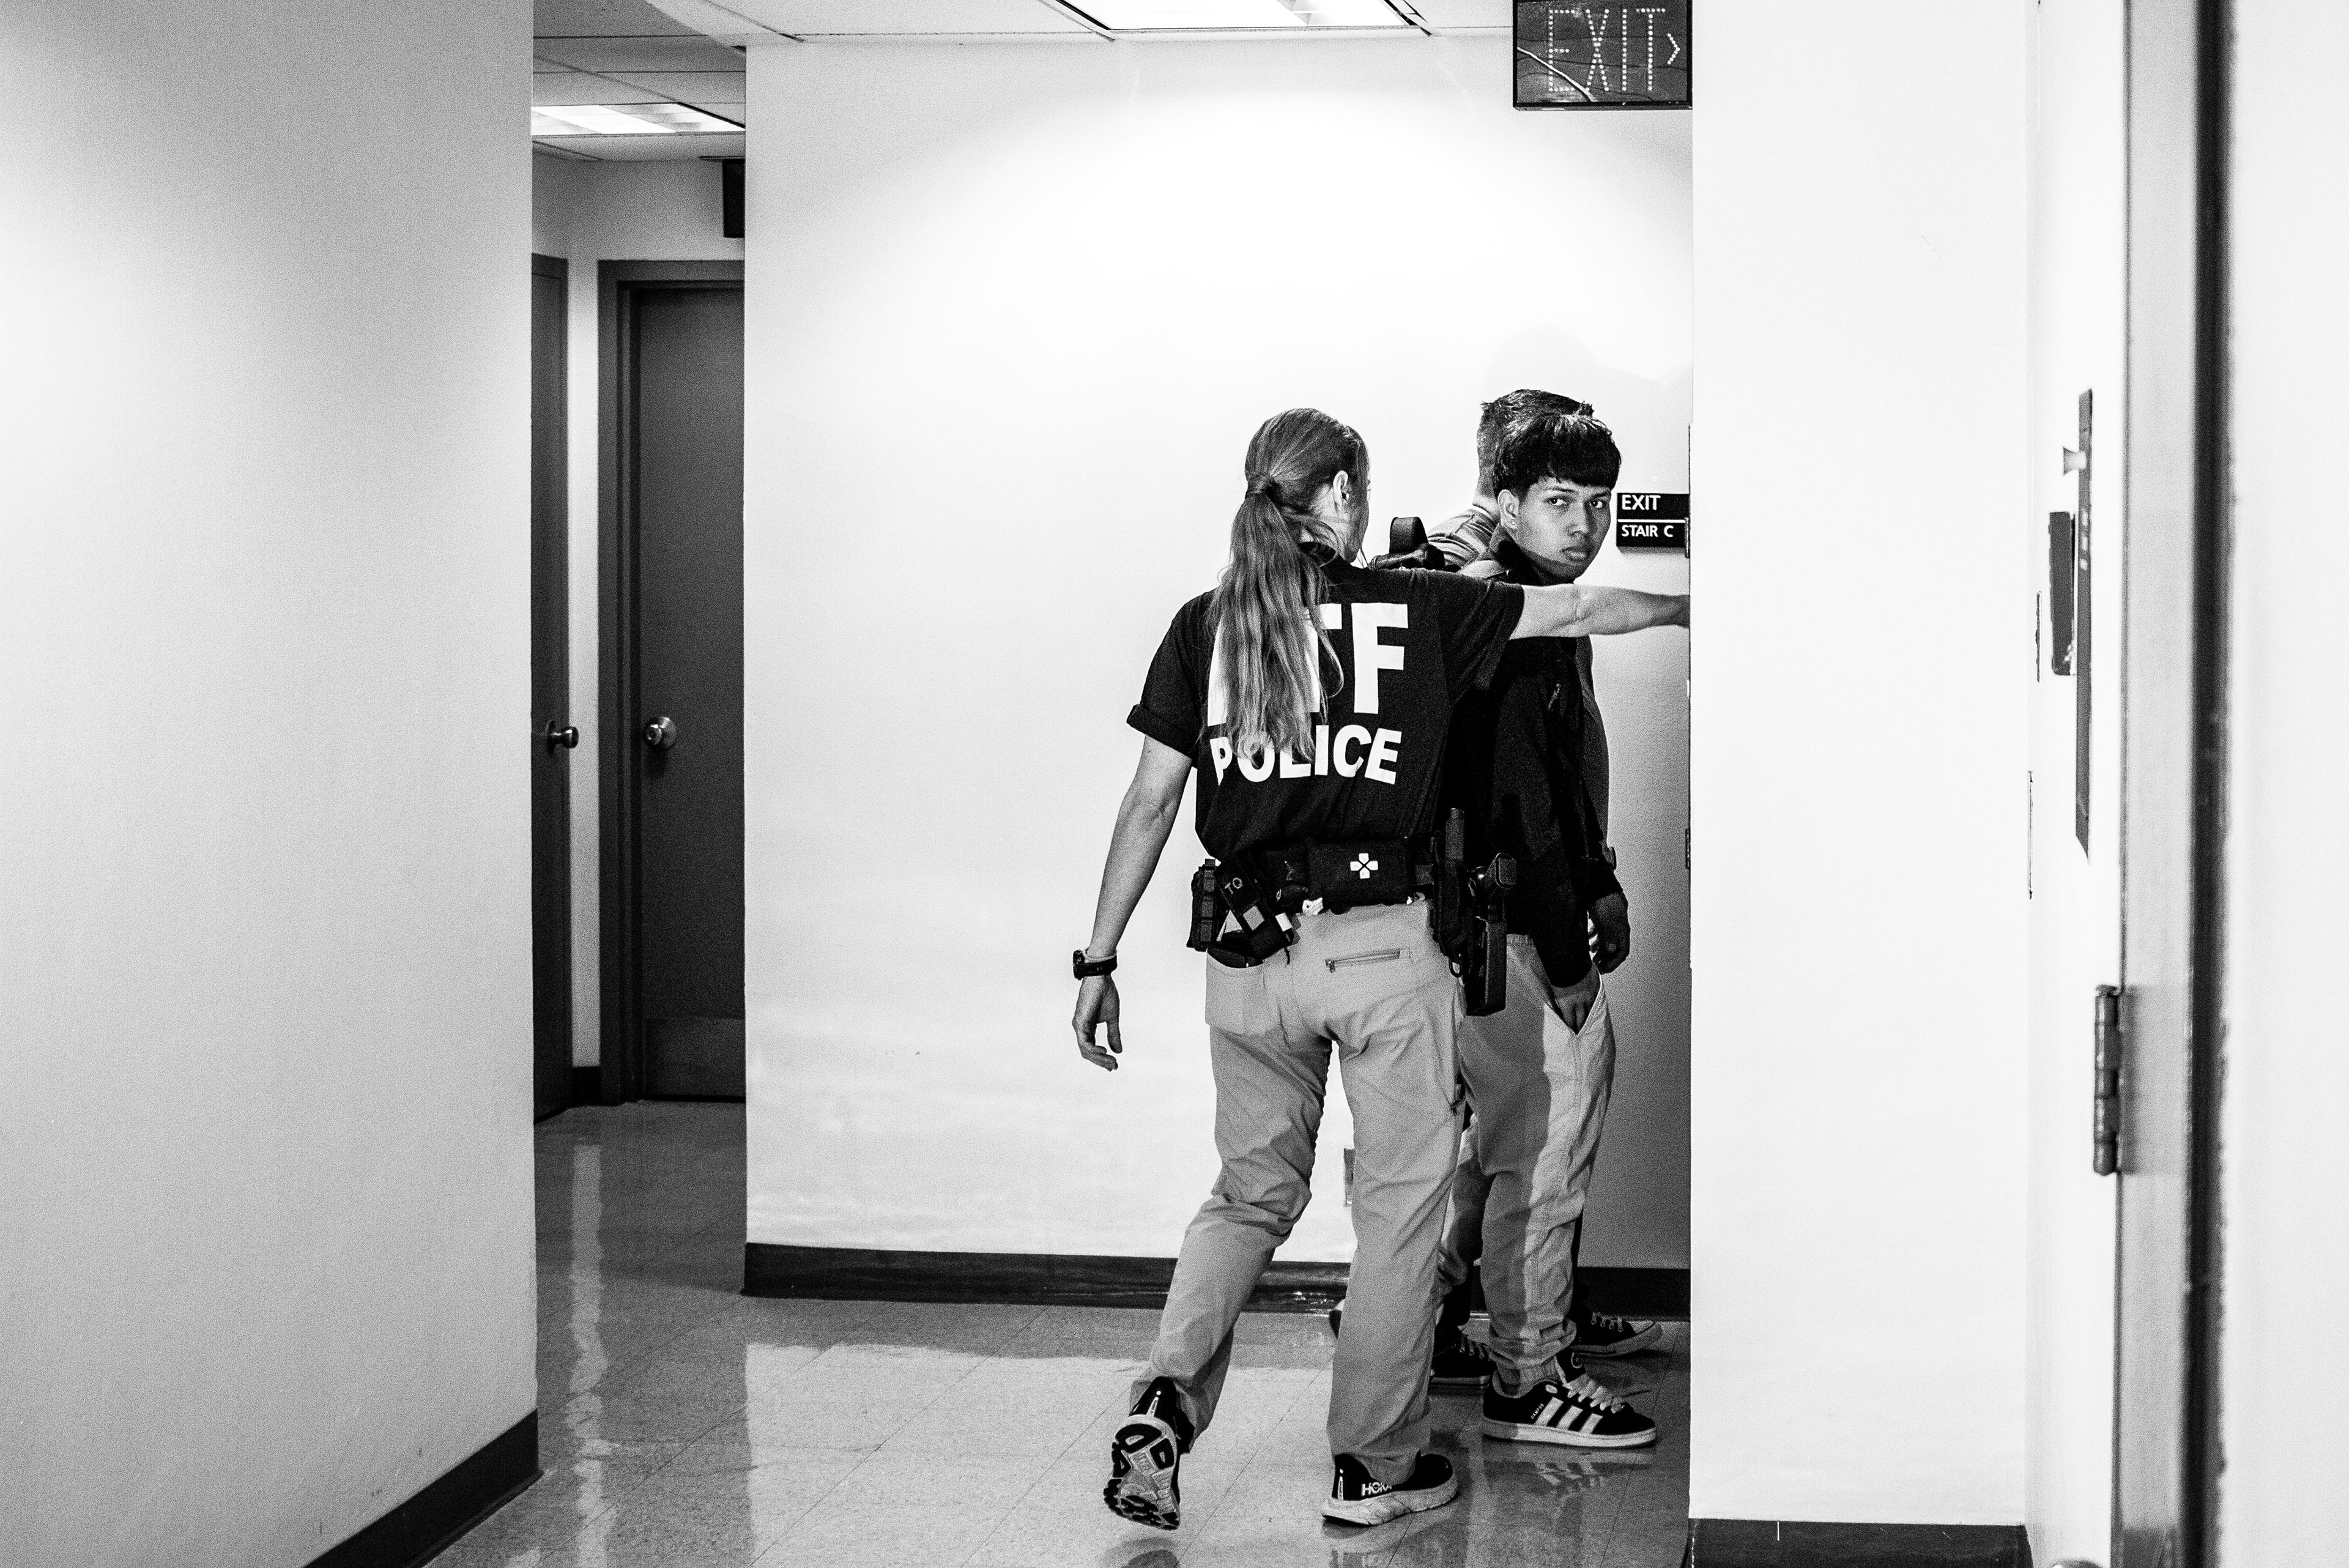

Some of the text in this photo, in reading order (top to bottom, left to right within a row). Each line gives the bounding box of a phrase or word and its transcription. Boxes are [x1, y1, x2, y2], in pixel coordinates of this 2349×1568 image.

[1548, 8, 1666, 92] EXIT
[1622, 494, 1661, 510] EXIT
[1622, 524, 1674, 537] STAIR C
[1209, 724, 1402, 786] POLICE
[1225, 877, 1244, 894] TQ
